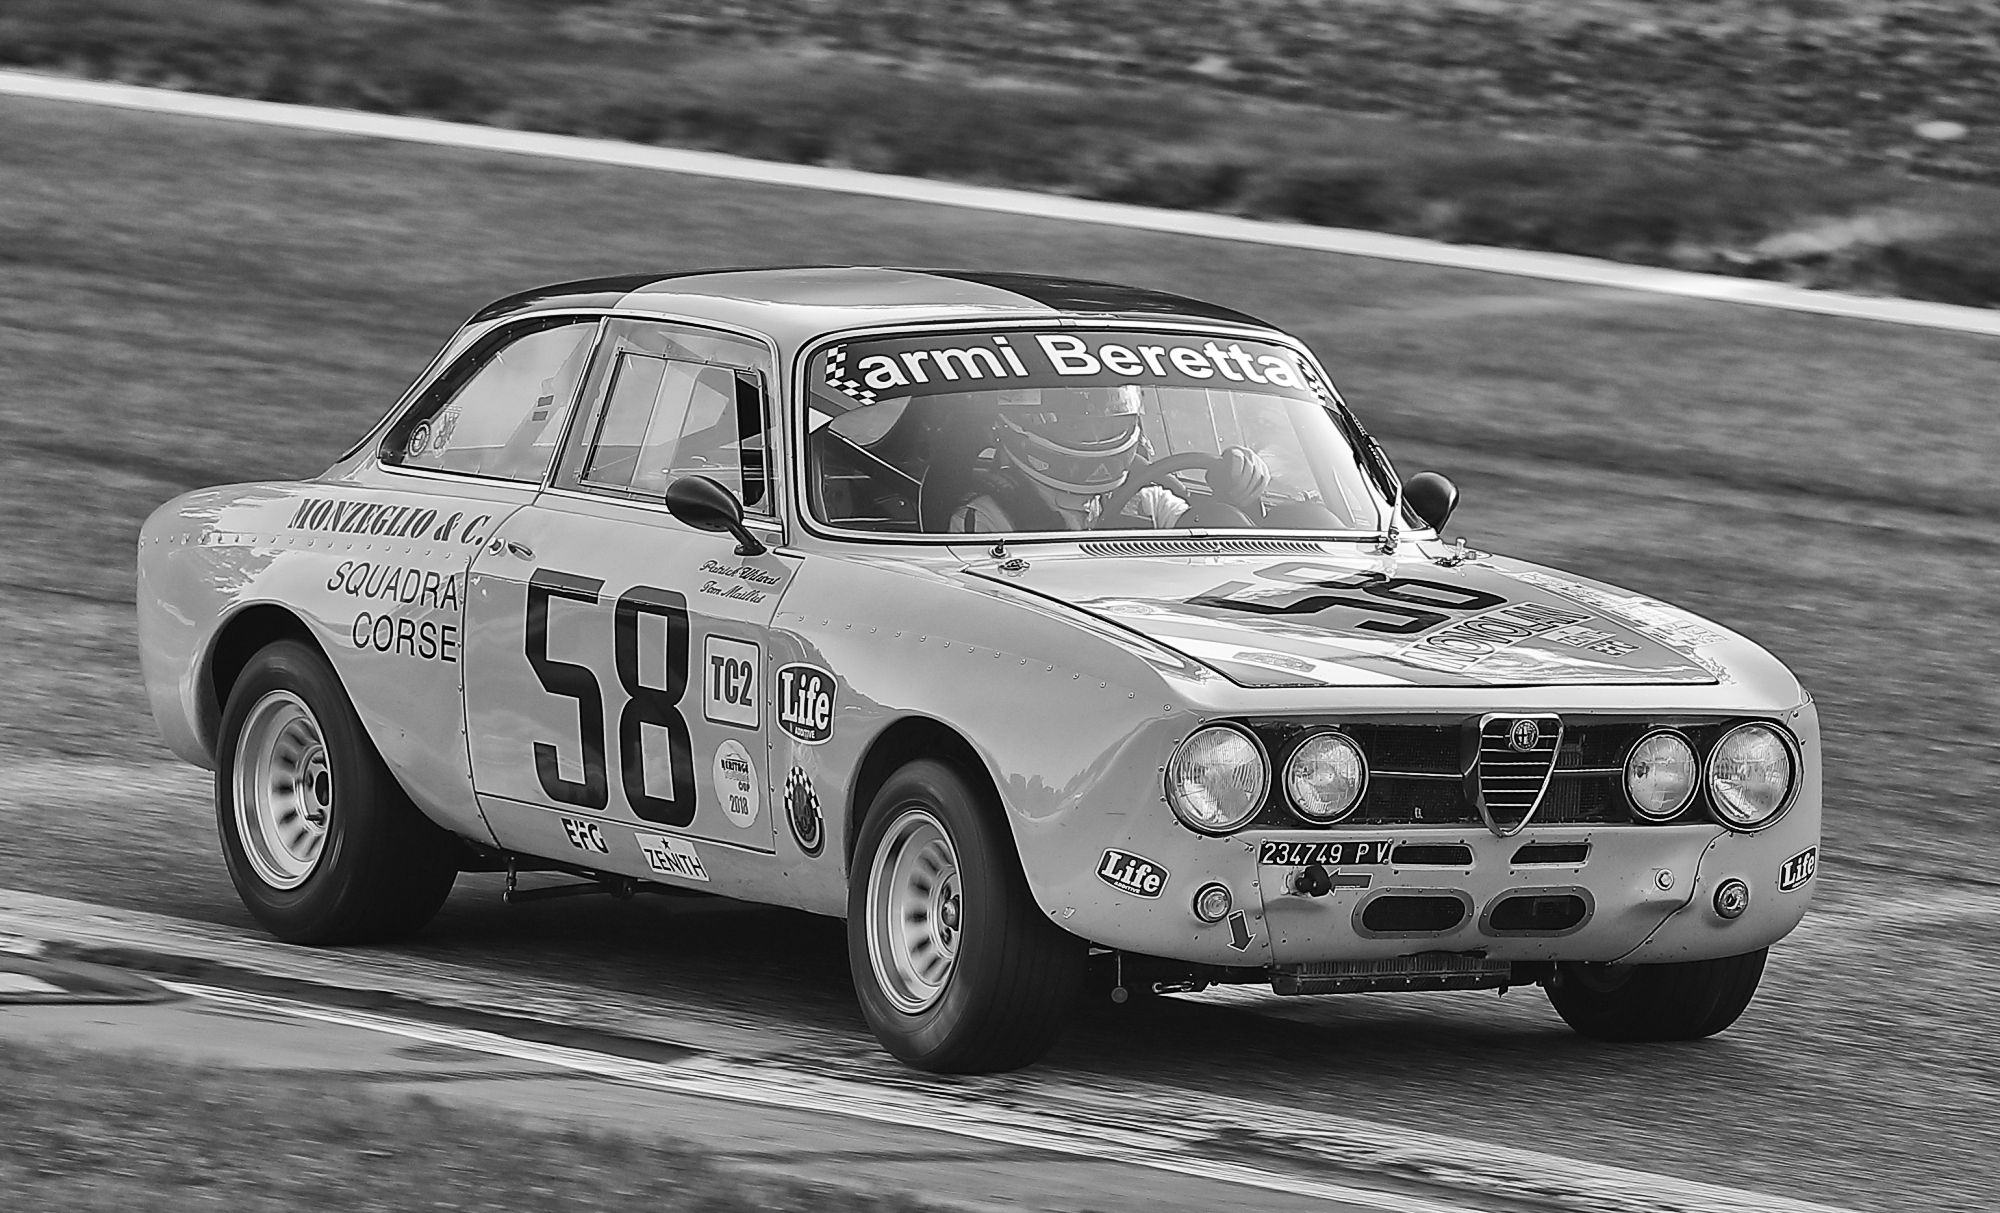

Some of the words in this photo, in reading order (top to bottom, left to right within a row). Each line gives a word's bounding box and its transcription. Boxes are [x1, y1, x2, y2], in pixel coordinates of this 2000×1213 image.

[857, 335, 1029, 391] armi
[1033, 333, 1307, 392] Beretta
[287, 498, 438, 539] MONZEGLIO
[433, 512, 464, 542] &
[460, 515, 492, 546] C.
[327, 561, 459, 612] SQUADRA
[352, 612, 458, 663] CORSE
[525, 568, 698, 828] 58
[710, 655, 753, 707] TC2
[781, 671, 830, 730] Life
[729, 794, 749, 815] 2018
[560, 817, 610, 854] EFG
[1262, 843, 1343, 865] 234749
[1354, 843, 1370, 864] P
[1377, 843, 1389, 863] V
[643, 848, 708, 878] ZENITH
[1101, 851, 1161, 893] Life
[1782, 852, 1815, 888] Life
